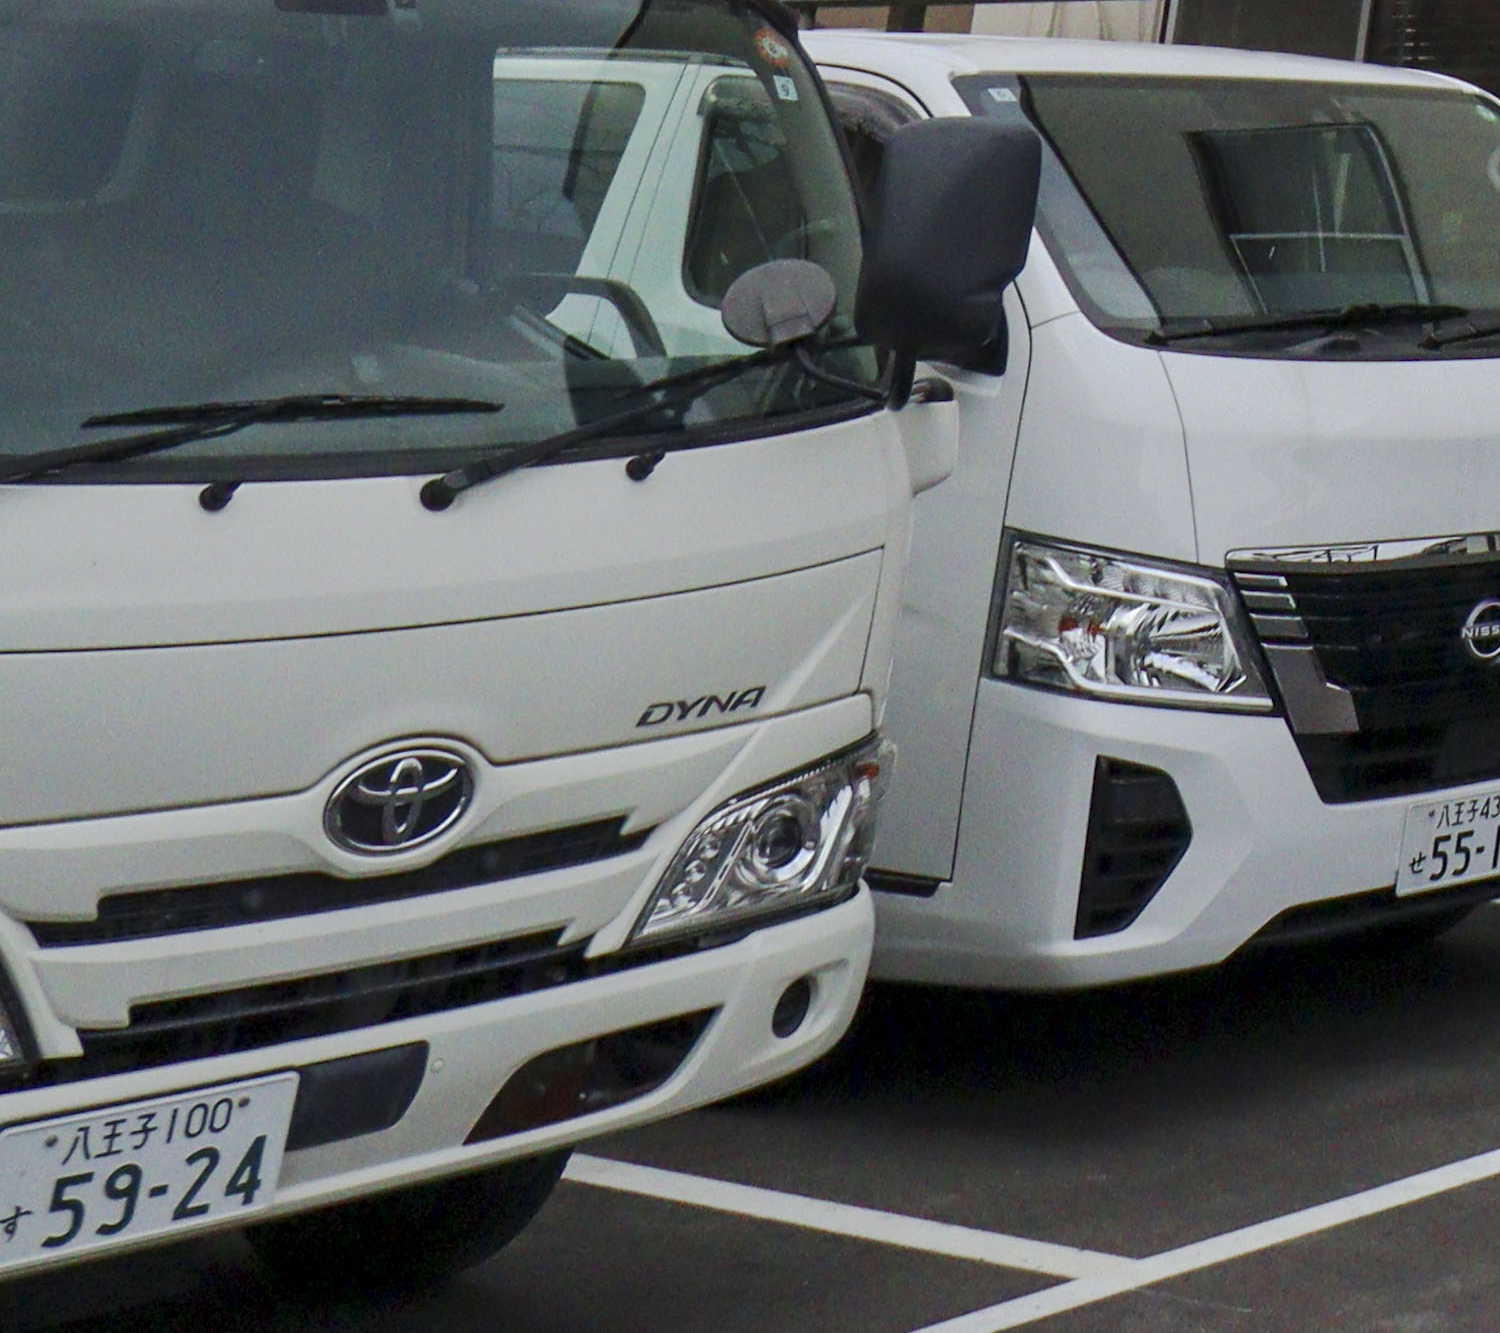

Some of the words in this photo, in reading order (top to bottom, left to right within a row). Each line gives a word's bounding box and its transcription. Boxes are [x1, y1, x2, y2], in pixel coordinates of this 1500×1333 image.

[635, 685, 767, 728] DYNA
[1409, 851, 1427, 874] せ
[41, 1134, 267, 1248] 59-24
